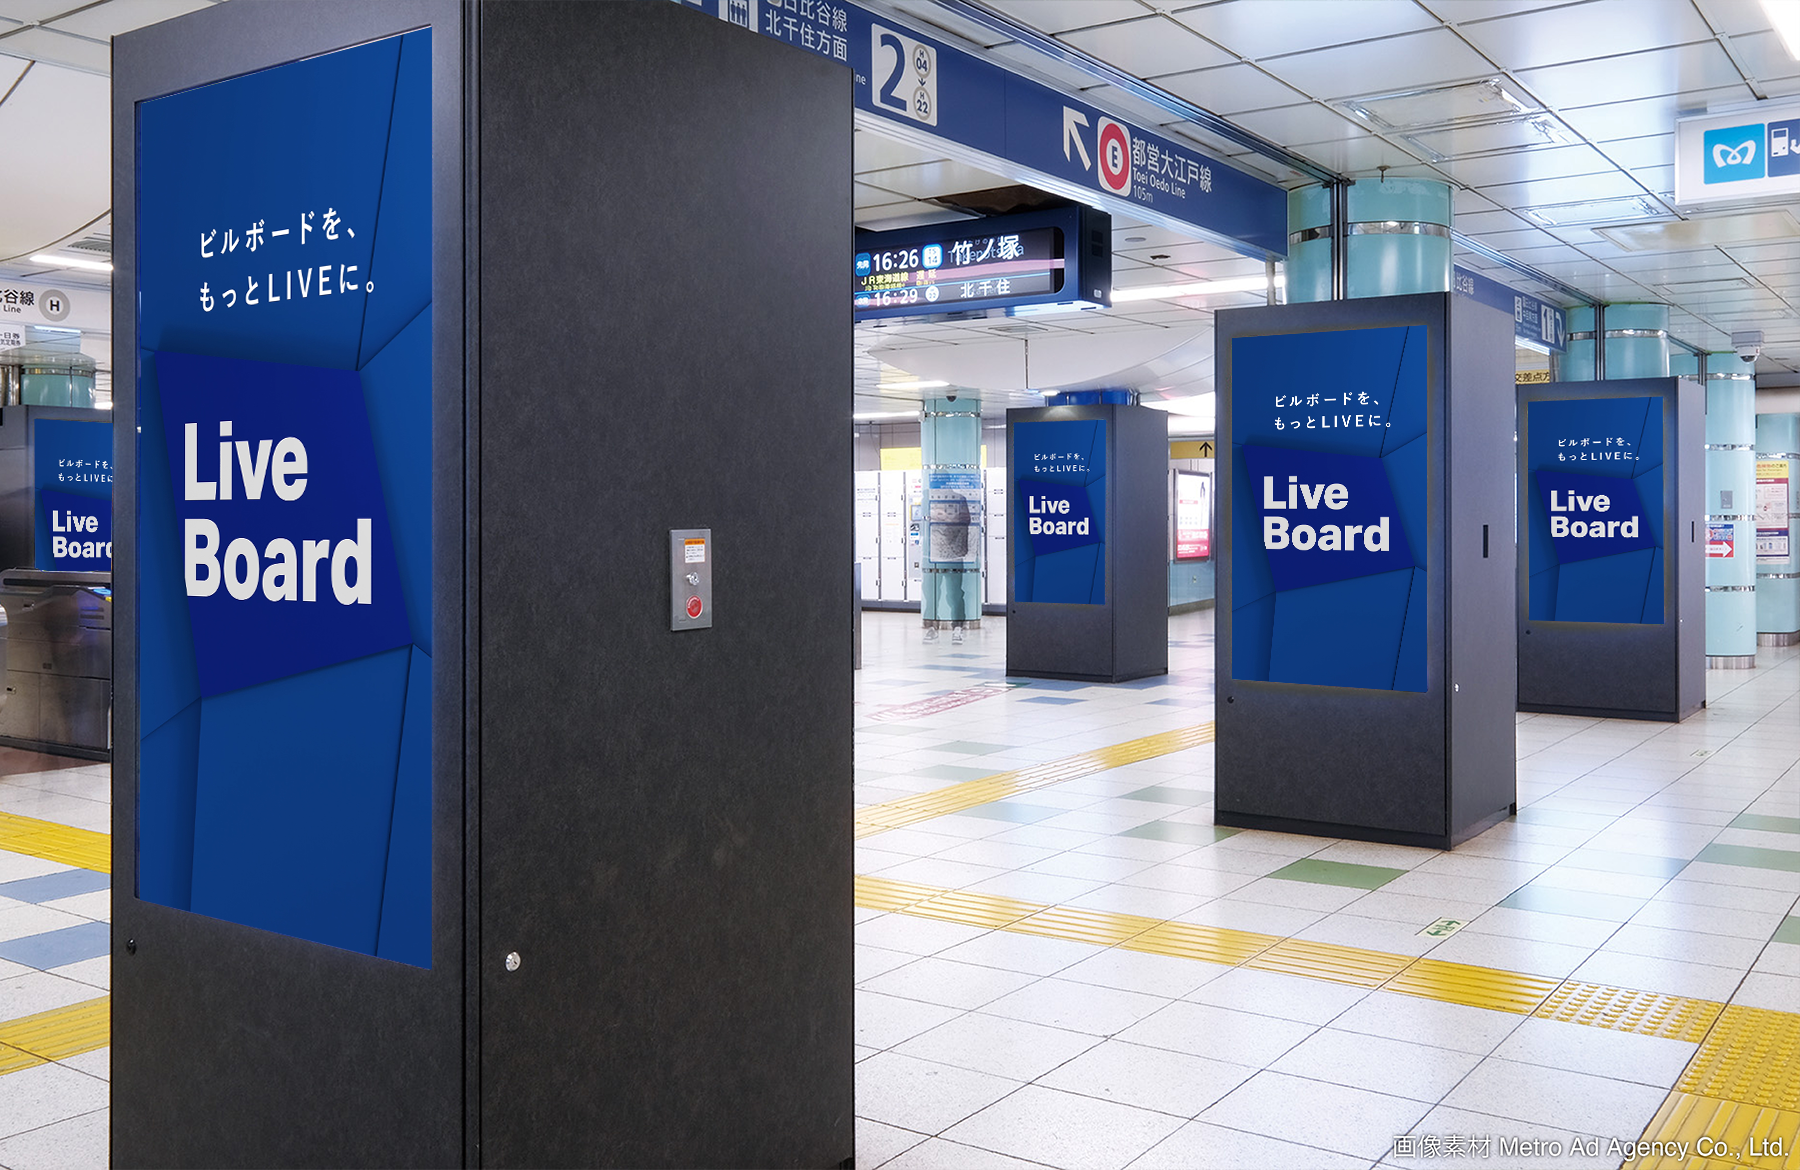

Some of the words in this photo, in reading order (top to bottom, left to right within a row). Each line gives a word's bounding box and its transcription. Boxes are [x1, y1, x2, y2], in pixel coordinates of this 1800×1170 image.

[765, 9, 848, 62] 北千住方面
[879, 33, 908, 112] 2
[916, 58, 929, 73] 04
[916, 98, 929, 115] 22
[1111, 145, 1119, 168] E
[1132, 137, 1213, 193] 都営大江戸線
[1133, 167, 1148, 183] Toei
[1149, 174, 1170, 193] Oedo
[1171, 183, 1186, 199] Line
[1133, 185, 1154, 203] 105m
[200, 207, 357, 258] ビルボードを、
[873, 249, 919, 272] 16:26
[952, 235, 1019, 266] 竹ノ塚
[0, 289, 35, 306] 谷線
[199, 264, 375, 312] もっとLIVEに。
[875, 288, 918, 307] 16:29
[960, 279, 1011, 298] 北千住
[3, 305, 22, 314] Line
[49, 299, 61, 312] H
[1275, 391, 1379, 408] ビルボードを、
[1275, 414, 1391, 430] もっとLIVEに。
[1558, 437, 1632, 447] ビルボードを、
[184, 420, 309, 501] Live
[1034, 452, 1085, 461] ビルボードを、
[1558, 452, 1640, 461] もっとLIVEに。
[1034, 464, 1091, 473] もっとLIVEに。
[1263, 475, 1349, 510] Live
[1550, 490, 1611, 512] Live
[1029, 495, 1070, 514] Live
[52, 510, 99, 533] Live
[1029, 517, 1090, 535] Board
[1550, 515, 1639, 538] Board
[1263, 516, 1390, 552] Board
[184, 518, 372, 606] Board
